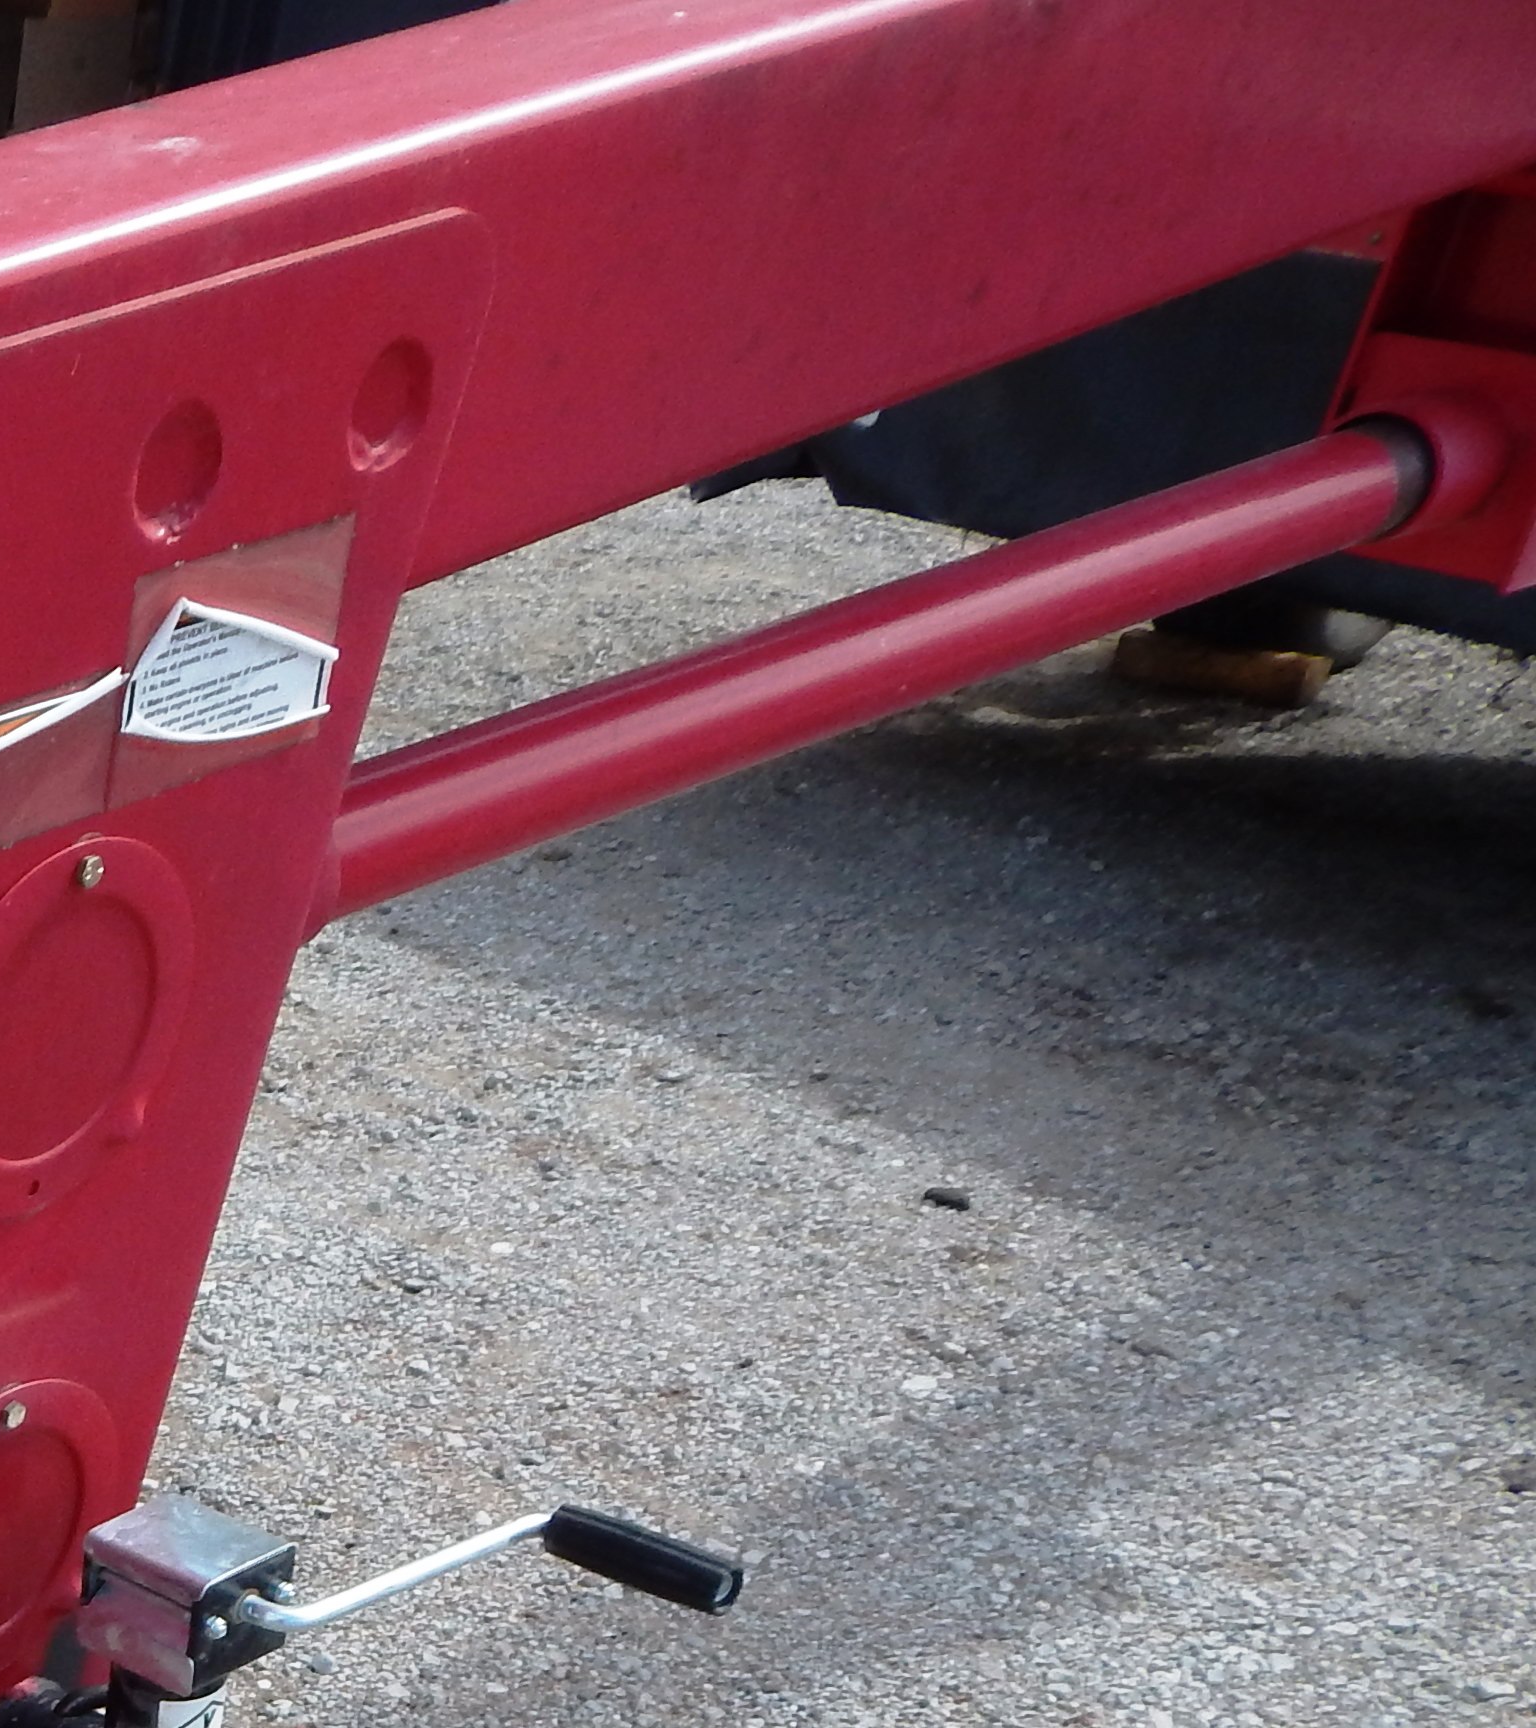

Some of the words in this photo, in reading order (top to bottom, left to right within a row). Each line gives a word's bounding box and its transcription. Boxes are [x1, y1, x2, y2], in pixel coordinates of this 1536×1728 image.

[147, 696, 164, 708] Make
[165, 690, 187, 702] certain
[187, 678, 218, 696] everyone
